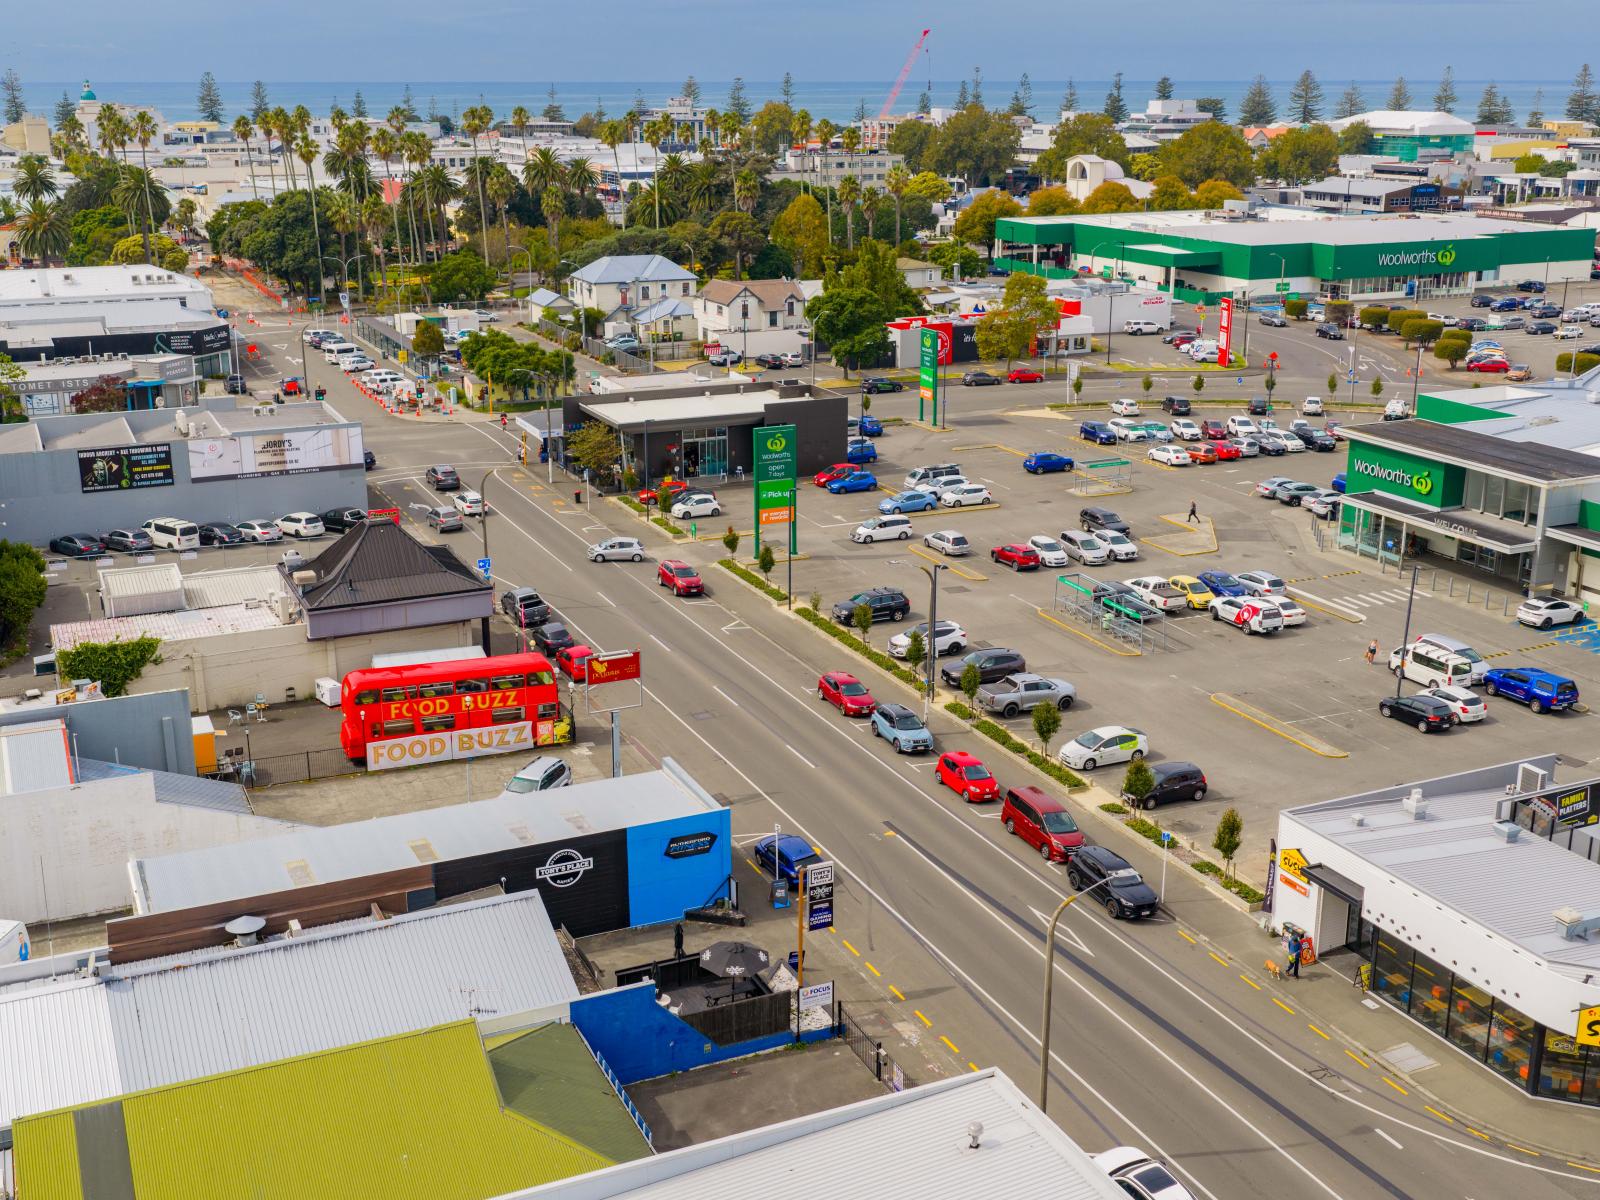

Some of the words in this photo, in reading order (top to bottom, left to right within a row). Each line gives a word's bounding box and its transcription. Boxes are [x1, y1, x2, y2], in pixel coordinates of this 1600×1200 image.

[1378, 249, 1437, 266] Woolworths
[265, 440, 293, 449] JORDY'S
[768, 464, 785, 472] open
[1354, 458, 1412, 487] Woolworths
[768, 490, 783, 498] Pick
[1434, 517, 1478, 537] WELCOME
[390, 698, 450, 719] FOOD
[461, 691, 518, 711] BUZZ
[372, 737, 447, 765] FOOD
[458, 725, 528, 752] BUZZ
[1561, 791, 1586, 807] FAMILY
[1560, 800, 1587, 815] PLATTERS
[670, 836, 711, 848] RUTHERFORD
[540, 865, 566, 876] TONY'S
[566, 861, 590, 871] PLACE
[1283, 856, 1301, 872] SUSH
[810, 887, 833, 896] EXPORT
[809, 914, 832, 922] GAMING
[809, 918, 832, 926] LOUNGE
[809, 986, 831, 995] FOCUS
